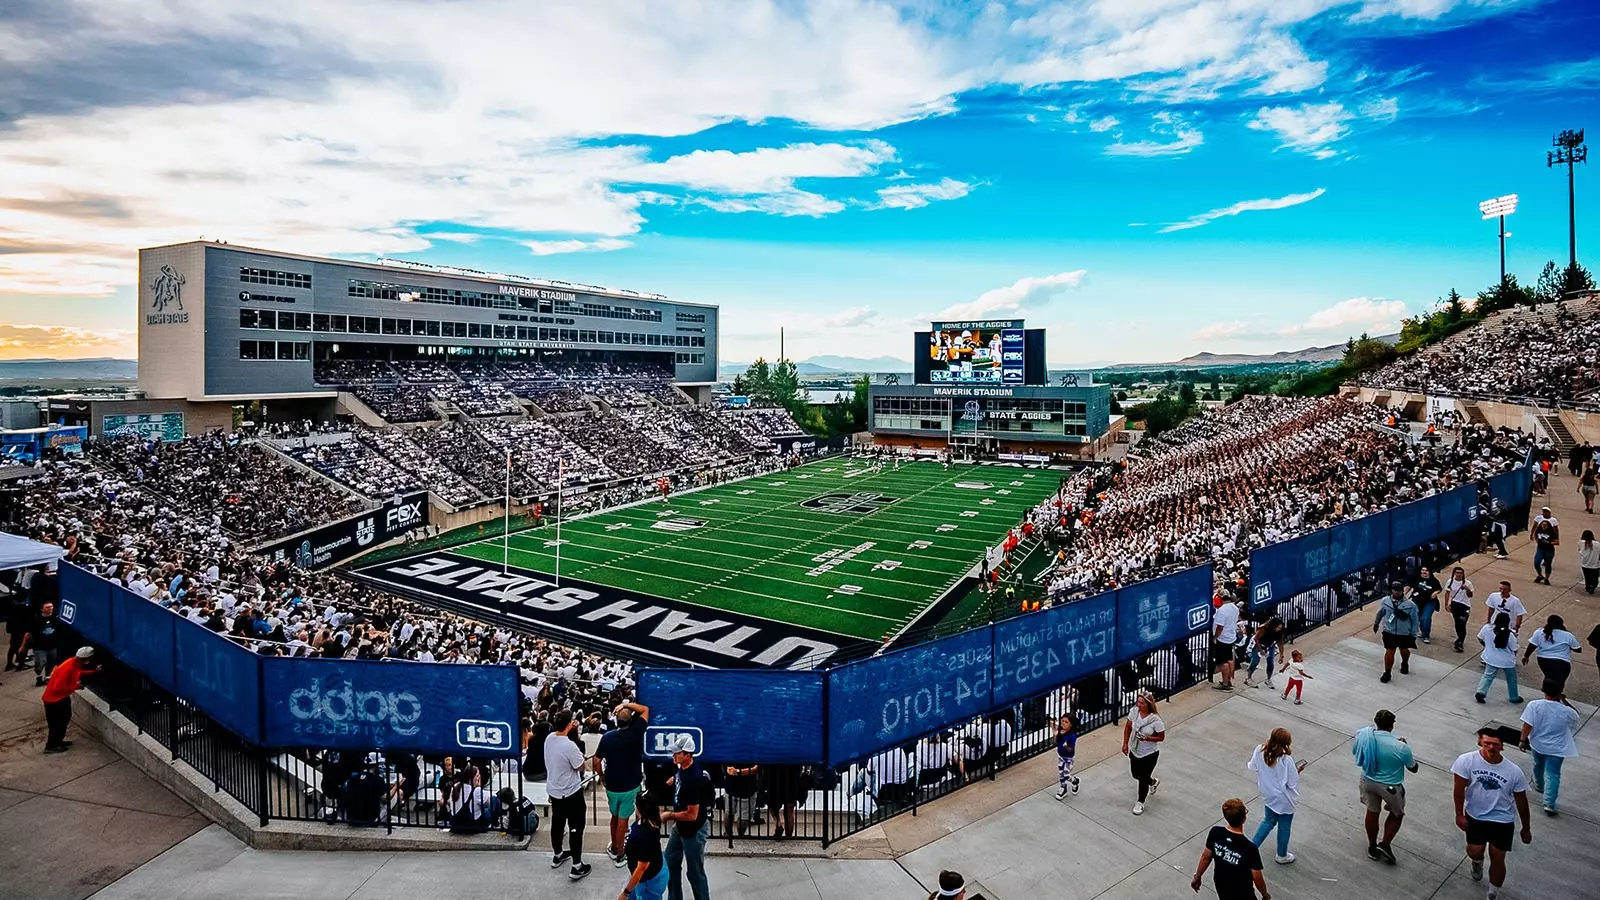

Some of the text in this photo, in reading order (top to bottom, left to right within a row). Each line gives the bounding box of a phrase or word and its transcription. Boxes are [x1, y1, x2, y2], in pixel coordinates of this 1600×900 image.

[499, 285, 576, 301] MAVERIK STADIUM
[147, 312, 190, 325] UTAH STATE
[933, 387, 1013, 396] MAVERIK STADIUM
[989, 411, 1052, 420] STATE AGGIES
[386, 500, 422, 527] FOX
[356, 524, 375, 539] STATE
[313, 536, 352, 555] Intermountain
[313, 552, 332, 565] Health
[1256, 584, 1269, 600] 114
[386, 557, 840, 672] UTAH STATE
[1192, 609, 1207, 625] 113
[466, 725, 503, 744] 113
[1489, 772, 1508, 784] STATE
